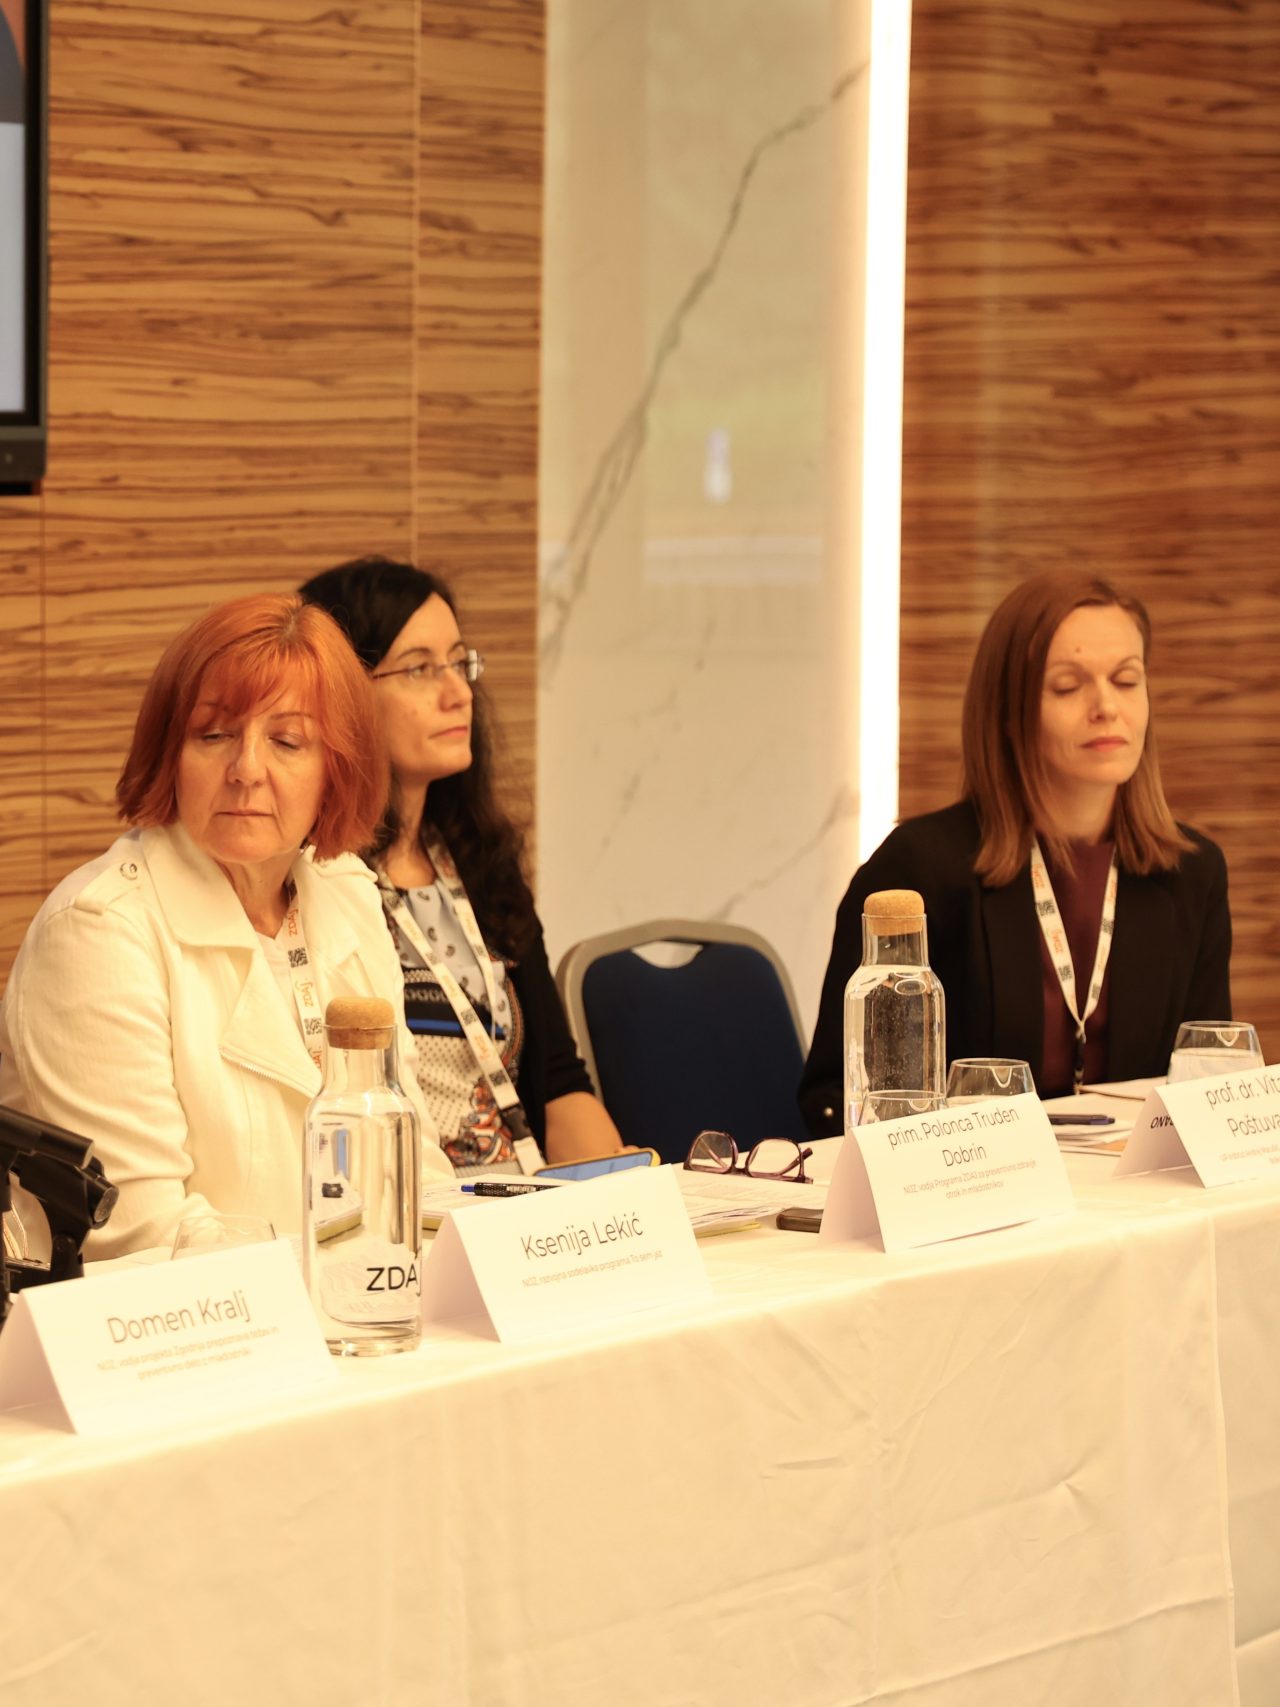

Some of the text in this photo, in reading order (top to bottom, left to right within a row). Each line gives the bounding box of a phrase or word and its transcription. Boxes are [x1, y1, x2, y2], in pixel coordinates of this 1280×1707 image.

[1205, 1081, 1239, 1111] prof.
[1238, 1078, 1260, 1100] dr.
[887, 1107, 1021, 1151] prim. Polonca Truden
[941, 1143, 988, 1167] Dobrin
[520, 1211, 644, 1260] Ksenija Lekić
[365, 1262, 421, 1297] ZDA
[106, 1289, 251, 1345] Domen Kralj
